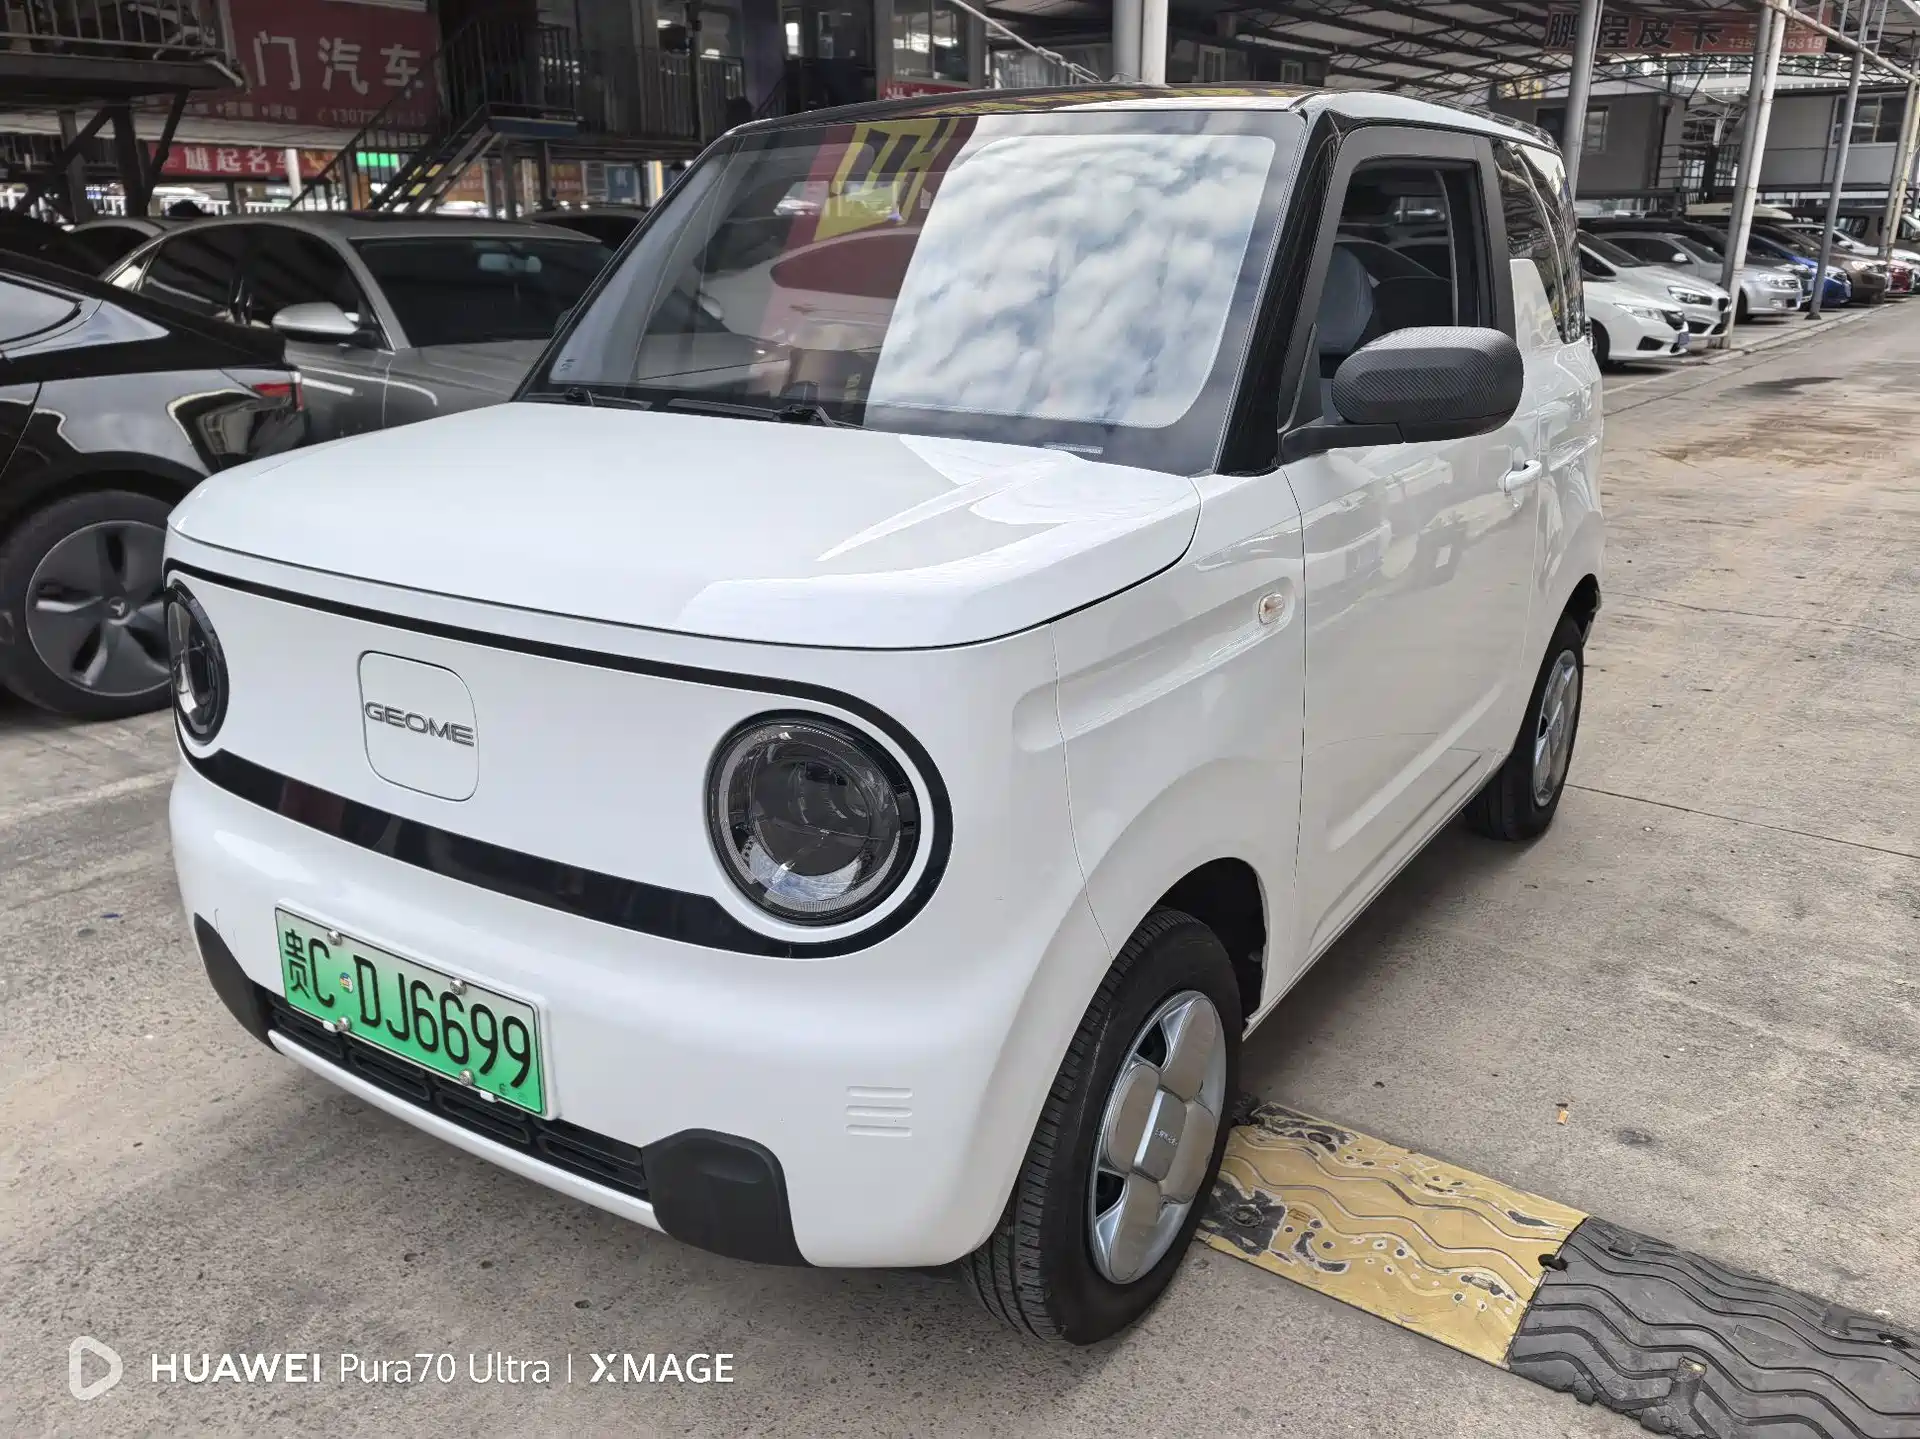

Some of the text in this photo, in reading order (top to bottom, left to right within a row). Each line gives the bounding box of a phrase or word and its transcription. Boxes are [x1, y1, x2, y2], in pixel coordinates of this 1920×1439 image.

[364, 701, 475, 748] GEOME
[284, 928, 531, 1090] 贵C DJ6699
